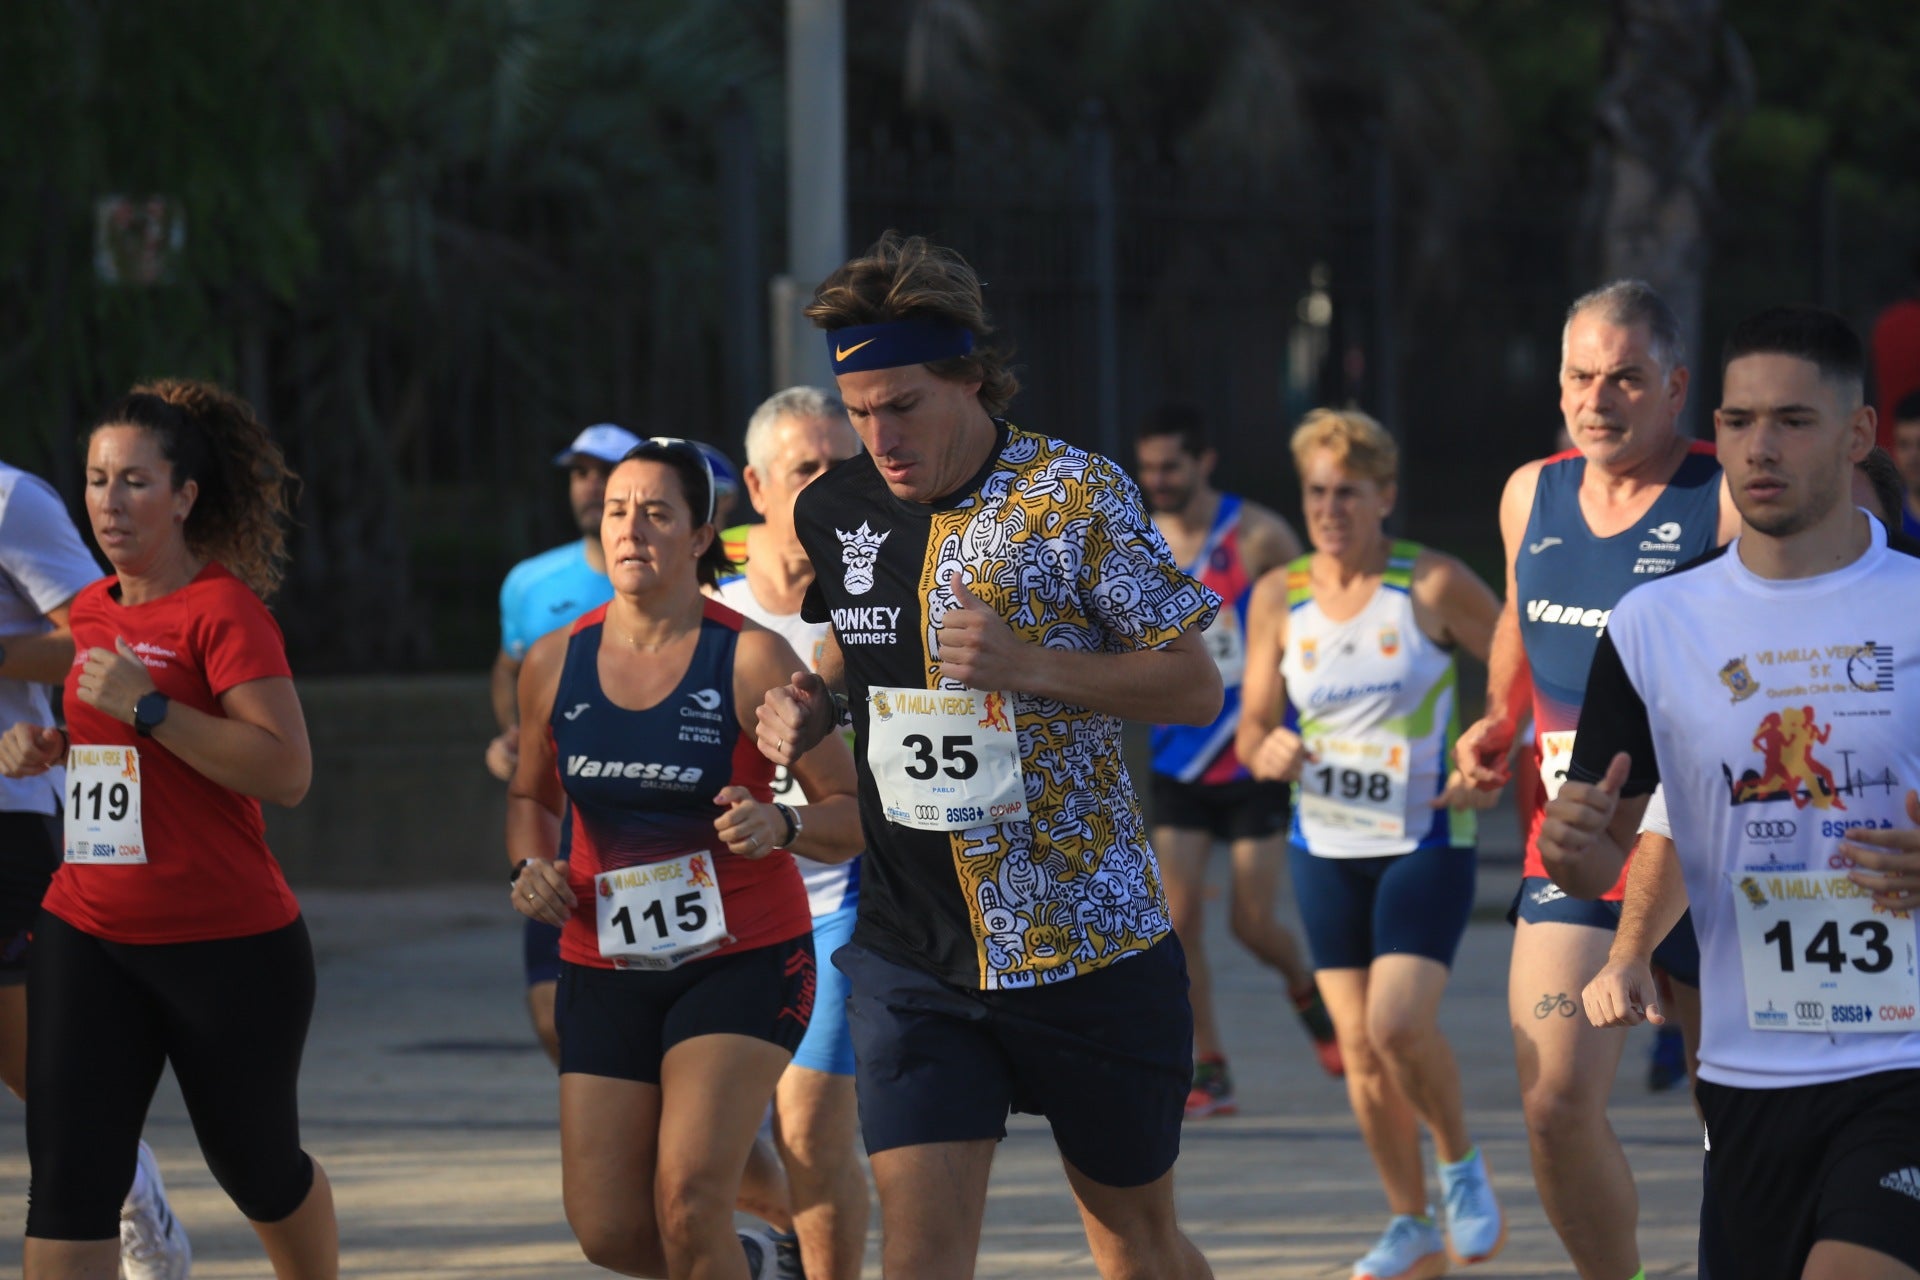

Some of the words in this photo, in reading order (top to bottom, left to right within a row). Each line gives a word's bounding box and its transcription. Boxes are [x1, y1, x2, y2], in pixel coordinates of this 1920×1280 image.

[830, 606, 901, 632] MONKEY
[842, 632, 897, 645] runners
[895, 692, 906, 713] VII
[908, 694, 937, 716] MILLA
[938, 696, 976, 716] VERDE
[678, 732, 690, 741] EL
[693, 733, 721, 745] BOLA
[680, 725, 721, 736] PINTURAS
[902, 733, 978, 781] 35
[566, 755, 704, 784] Vanessa
[1315, 766, 1391, 802] 198
[71, 782, 129, 821] 119
[989, 801, 1022, 817] COVAP
[946, 806, 976, 823] asisa
[1784, 876, 1824, 901] MILLA
[611, 891, 708, 946] 115
[1764, 919, 1894, 974] 143
[1831, 1004, 1864, 1023] asisa
[1879, 1005, 1916, 1021] COVAP
